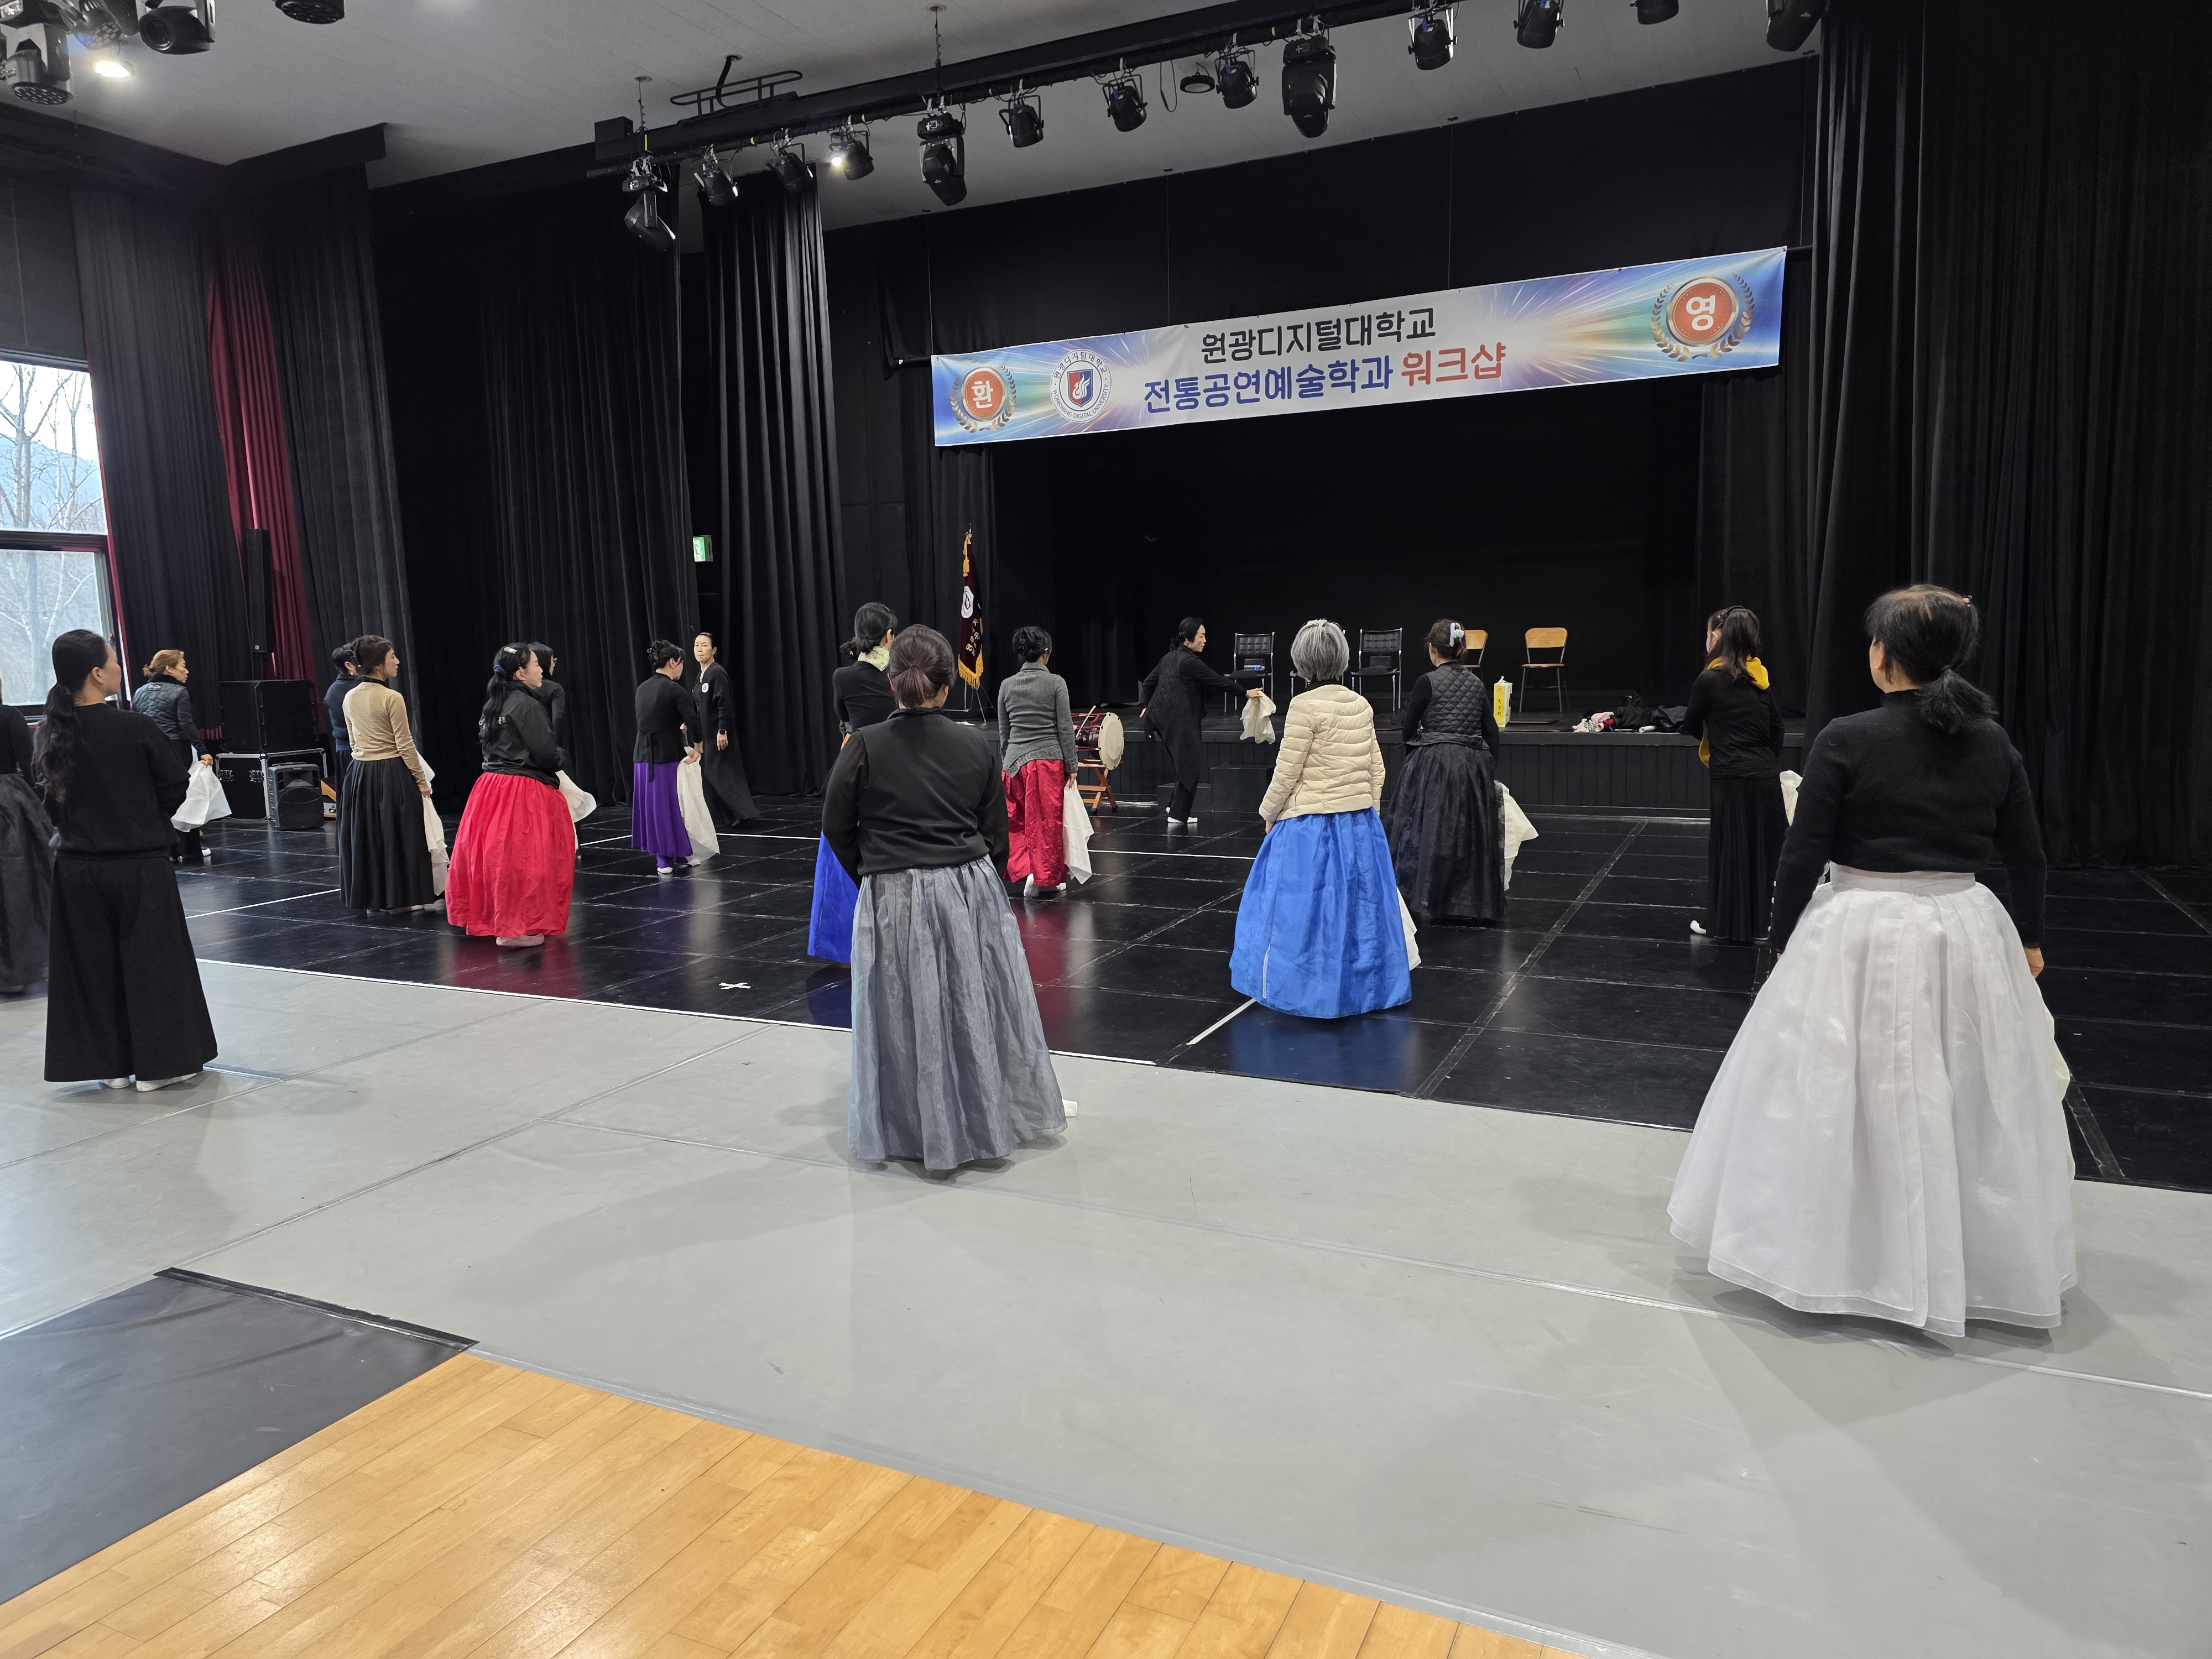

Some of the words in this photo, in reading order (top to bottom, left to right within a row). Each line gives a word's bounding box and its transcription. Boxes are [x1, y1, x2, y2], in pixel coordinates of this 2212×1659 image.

[1686, 295, 1716, 331] 영
[1201, 307, 1436, 364] 원광디지털대학교
[1054, 352, 1108, 379] 원광디지털대학교
[1144, 354, 1394, 414] 전통공연예술학과
[1401, 342, 1506, 387] 워크샵
[971, 380, 994, 409] 환
[1053, 389, 1073, 418] WONKWANG
[1093, 384, 1109, 414] UNIVERSITY
